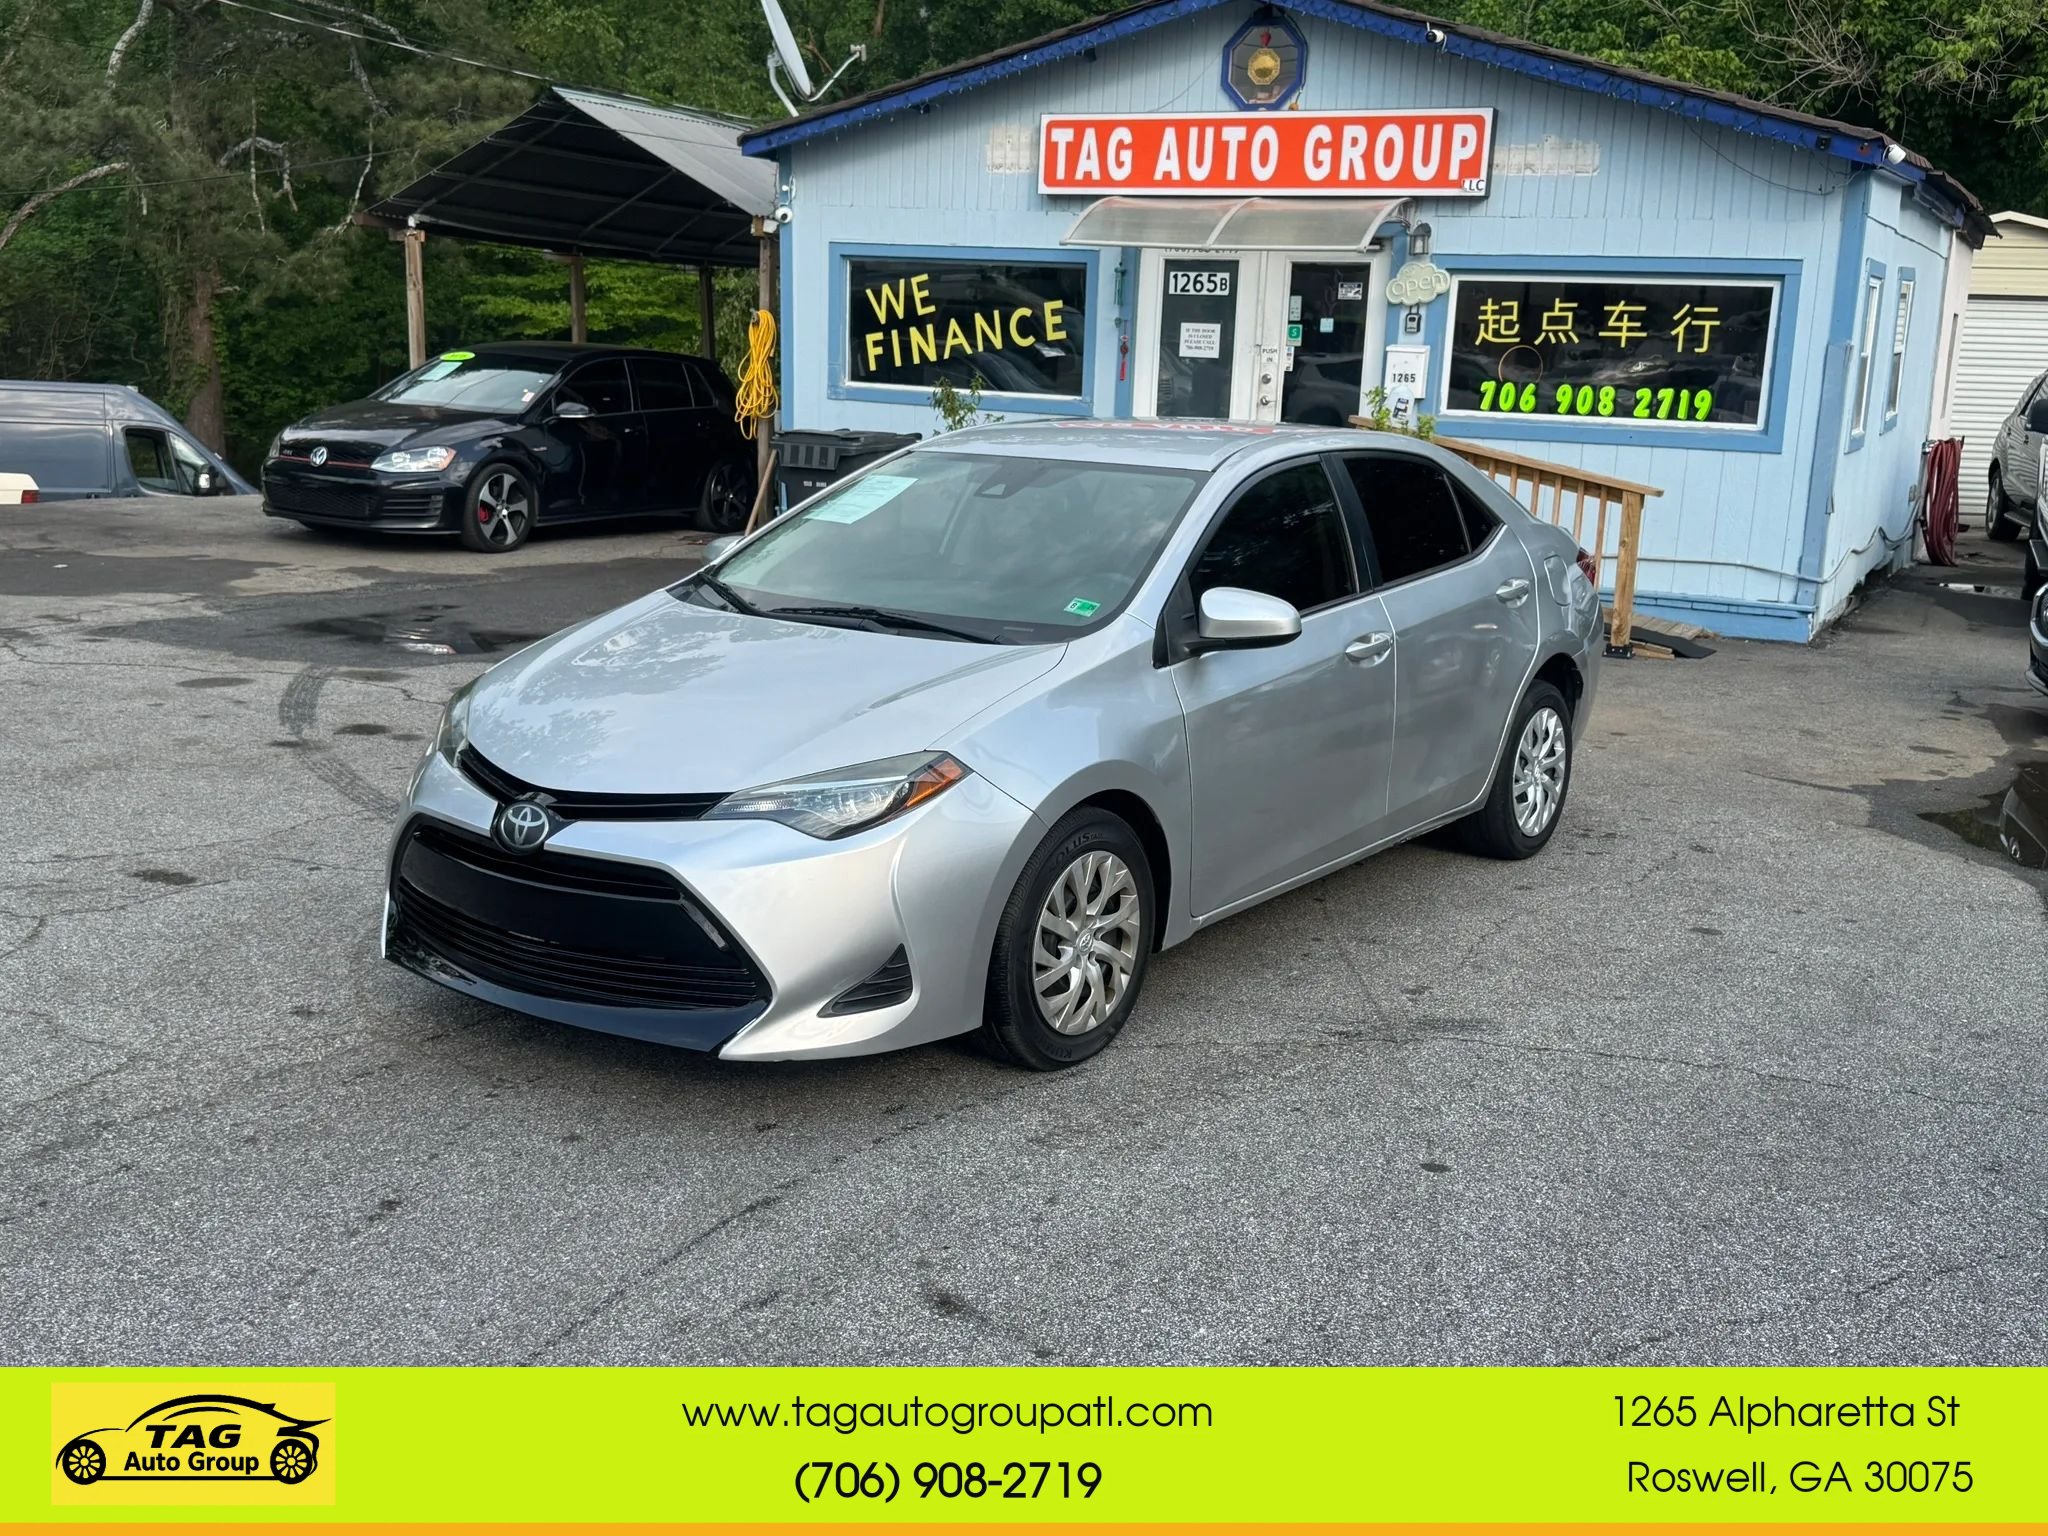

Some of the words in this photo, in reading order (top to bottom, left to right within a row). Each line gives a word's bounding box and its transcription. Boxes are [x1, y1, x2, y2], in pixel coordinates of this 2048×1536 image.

[1051, 127, 1133, 181] TAG
[1154, 125, 1279, 181] AUTO
[1303, 123, 1478, 181] GROUP
[866, 273, 936, 325] WE
[1475, 298, 1721, 353] 起点车行
[866, 300, 1067, 371] FINANCE
[1392, 373, 1416, 383] 1265
[1480, 380, 1536, 413] 706
[1556, 383, 1617, 416] 908
[1633, 387, 1713, 421] 2719
